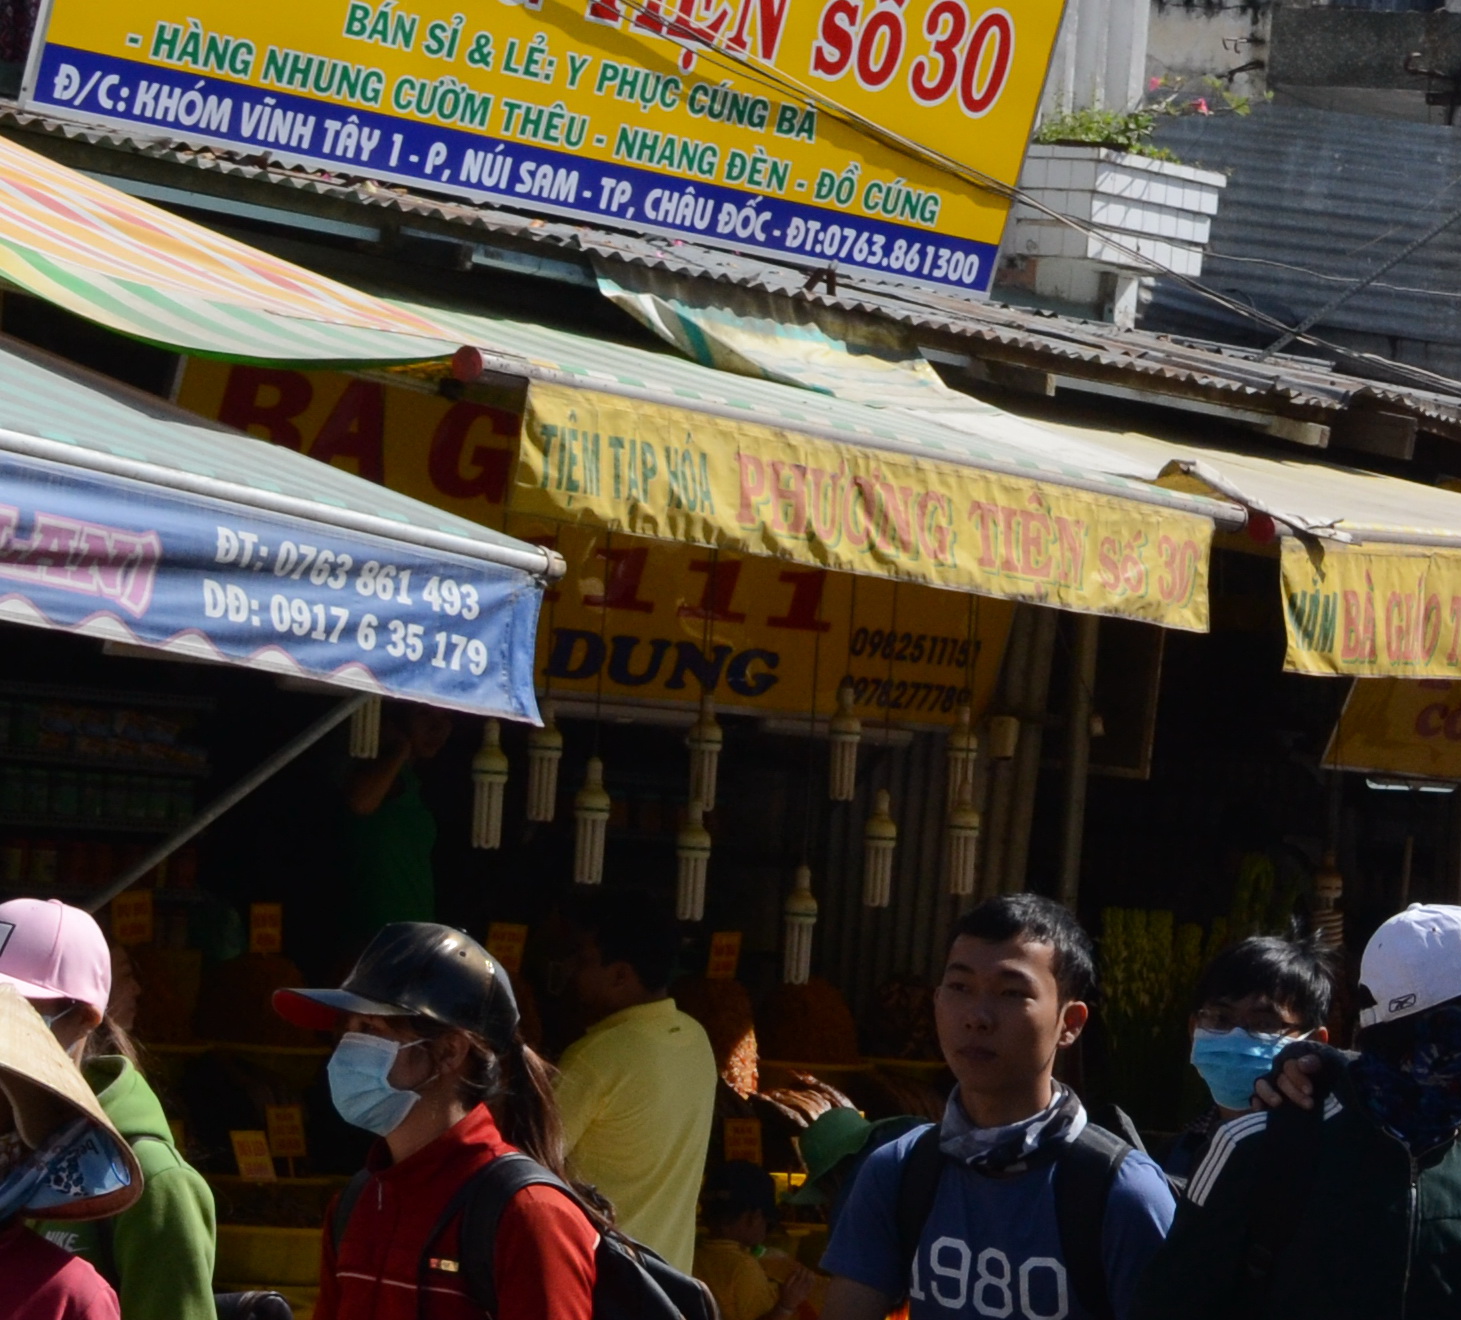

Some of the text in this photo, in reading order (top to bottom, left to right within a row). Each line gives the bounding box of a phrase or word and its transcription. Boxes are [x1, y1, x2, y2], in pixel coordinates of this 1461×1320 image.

[343, 0, 419, 52] BÁN
[423, 12, 465, 61] SỈ
[466, 30, 495, 70] &
[501, 31, 556, 84] LẺ:
[565, 51, 592, 90] Y
[595, 60, 683, 113] PHỤC
[687, 79, 770, 134] CÚNG
[909, 0, 1015, 118] 30
[53, 62, 130, 113] Đ/C:
[133, 80, 233, 134] KHÓM
[240, 97, 317, 151] VĨNH
[322, 115, 382, 162] TÂY
[388, 132, 404, 168] 1
[424, 141, 452, 183] P,
[459, 143, 513, 190] NÚI
[514, 160, 580, 203] SAM
[600, 177, 637, 220] TP,
[643, 186, 716, 231] CHÂU
[717, 194, 772, 243] ĐỐC
[150, 17, 942, 228] HÀNG NHUNG CƯỜM THÊU NHANG ĐÈN ĐỒ CÚNG
[541, 409, 600, 507] TIỆM
[735, 452, 951, 565] PHƯƠNG
[968, 490, 1087, 596] TIỆN
[1157, 534, 1200, 604] 30
[203, 578, 488, 676] DĐ: 0917 6 35 179
[215, 525, 481, 620] ĐT: 0763 861 493
[1341, 569, 1377, 664] BÀ
[1385, 570, 1442, 665] GIÁO
[542, 628, 779, 697] DUNG
